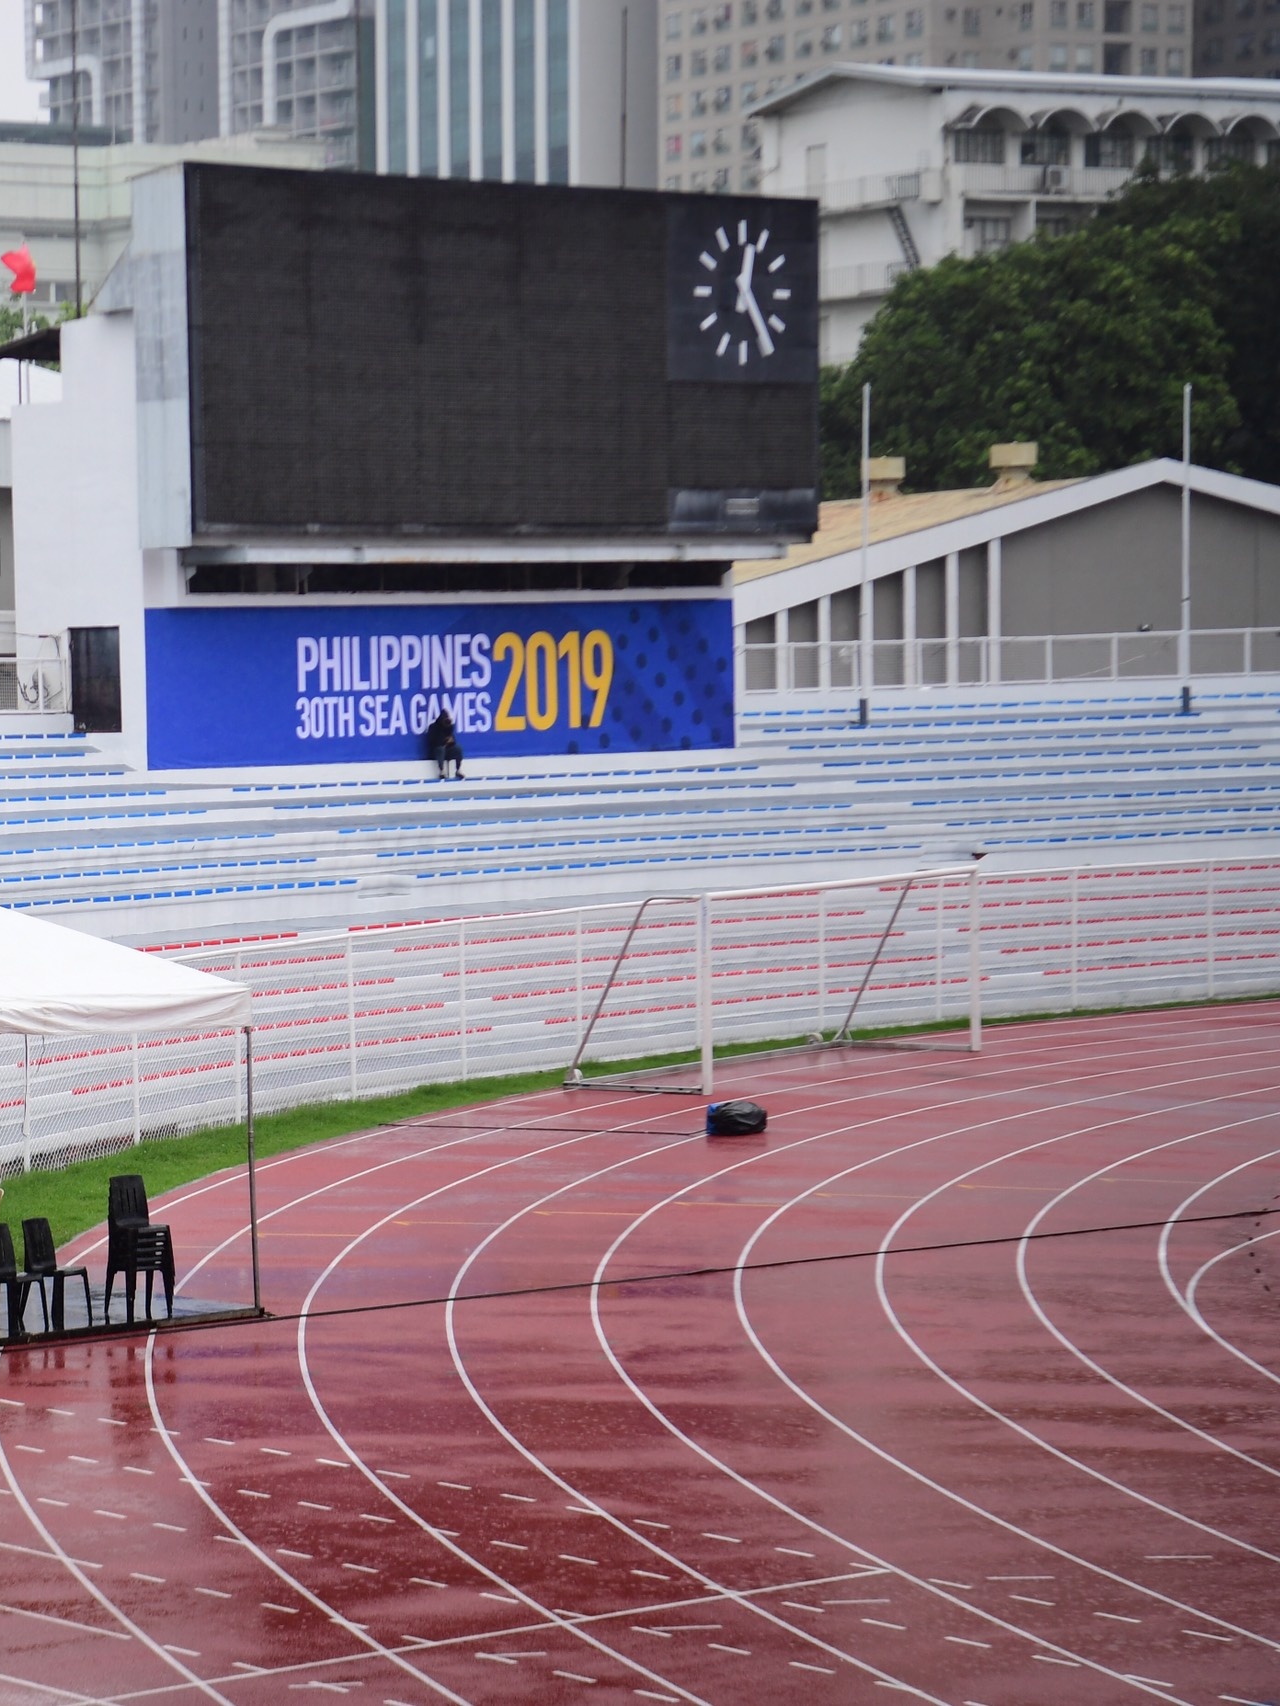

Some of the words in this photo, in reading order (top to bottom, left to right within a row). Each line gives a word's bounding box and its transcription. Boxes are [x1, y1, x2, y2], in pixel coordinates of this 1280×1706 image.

[297, 634, 492, 691] PHILIPPINES
[493, 629, 615, 732] 2019
[295, 695, 355, 739] 30TH
[359, 693, 408, 738] SEA
